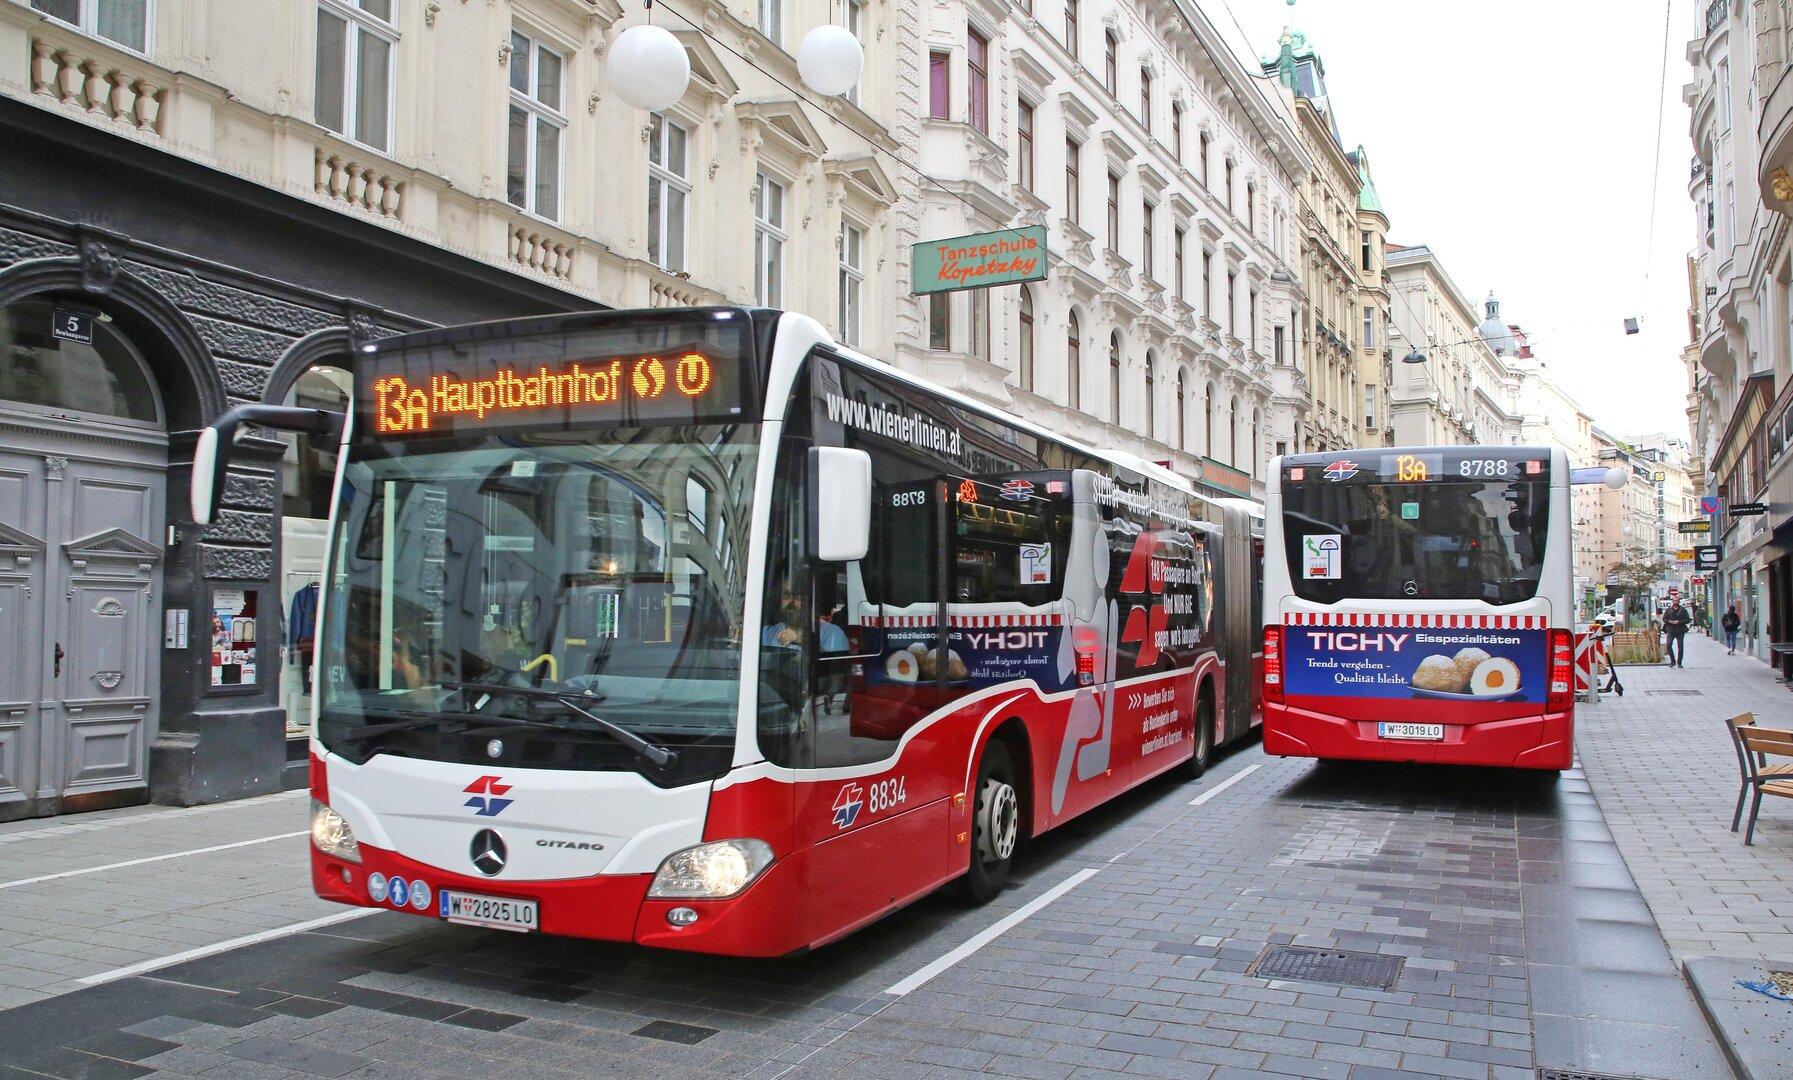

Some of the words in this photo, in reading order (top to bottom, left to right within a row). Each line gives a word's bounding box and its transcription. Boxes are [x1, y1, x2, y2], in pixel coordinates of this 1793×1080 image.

[937, 237, 1038, 262] Tanzschule
[937, 256, 1038, 284] Kopetzky
[67, 316, 79, 331] 5
[374, 376, 430, 432] 13A
[431, 360, 622, 420] Hauptbahnhof
[826, 392, 962, 456] www.wienerlinien.at
[1397, 455, 1426, 481] 13A
[1459, 459, 1508, 477] 8788
[1681, 523, 1711, 531] SUBWAY
[1163, 593, 1174, 614] Und
[1174, 594, 1185, 614] NUR
[1155, 630, 1169, 652] sagen
[1306, 631, 1409, 652] TICHY
[1415, 633, 1521, 645] Eisspezialitäten
[1306, 657, 1339, 669] Trends
[1341, 658, 1383, 671] vergehen
[1334, 673, 1375, 685] Qualität
[1377, 673, 1408, 685] bleibt.
[1387, 724, 1395, 735] W
[1402, 725, 1426, 736] 3019
[1428, 726, 1440, 736] LO
[869, 775, 907, 814] 8834
[535, 838, 605, 852] CITARO
[451, 896, 462, 915] W
[474, 899, 511, 922] 2825
[514, 904, 533, 924] LO
